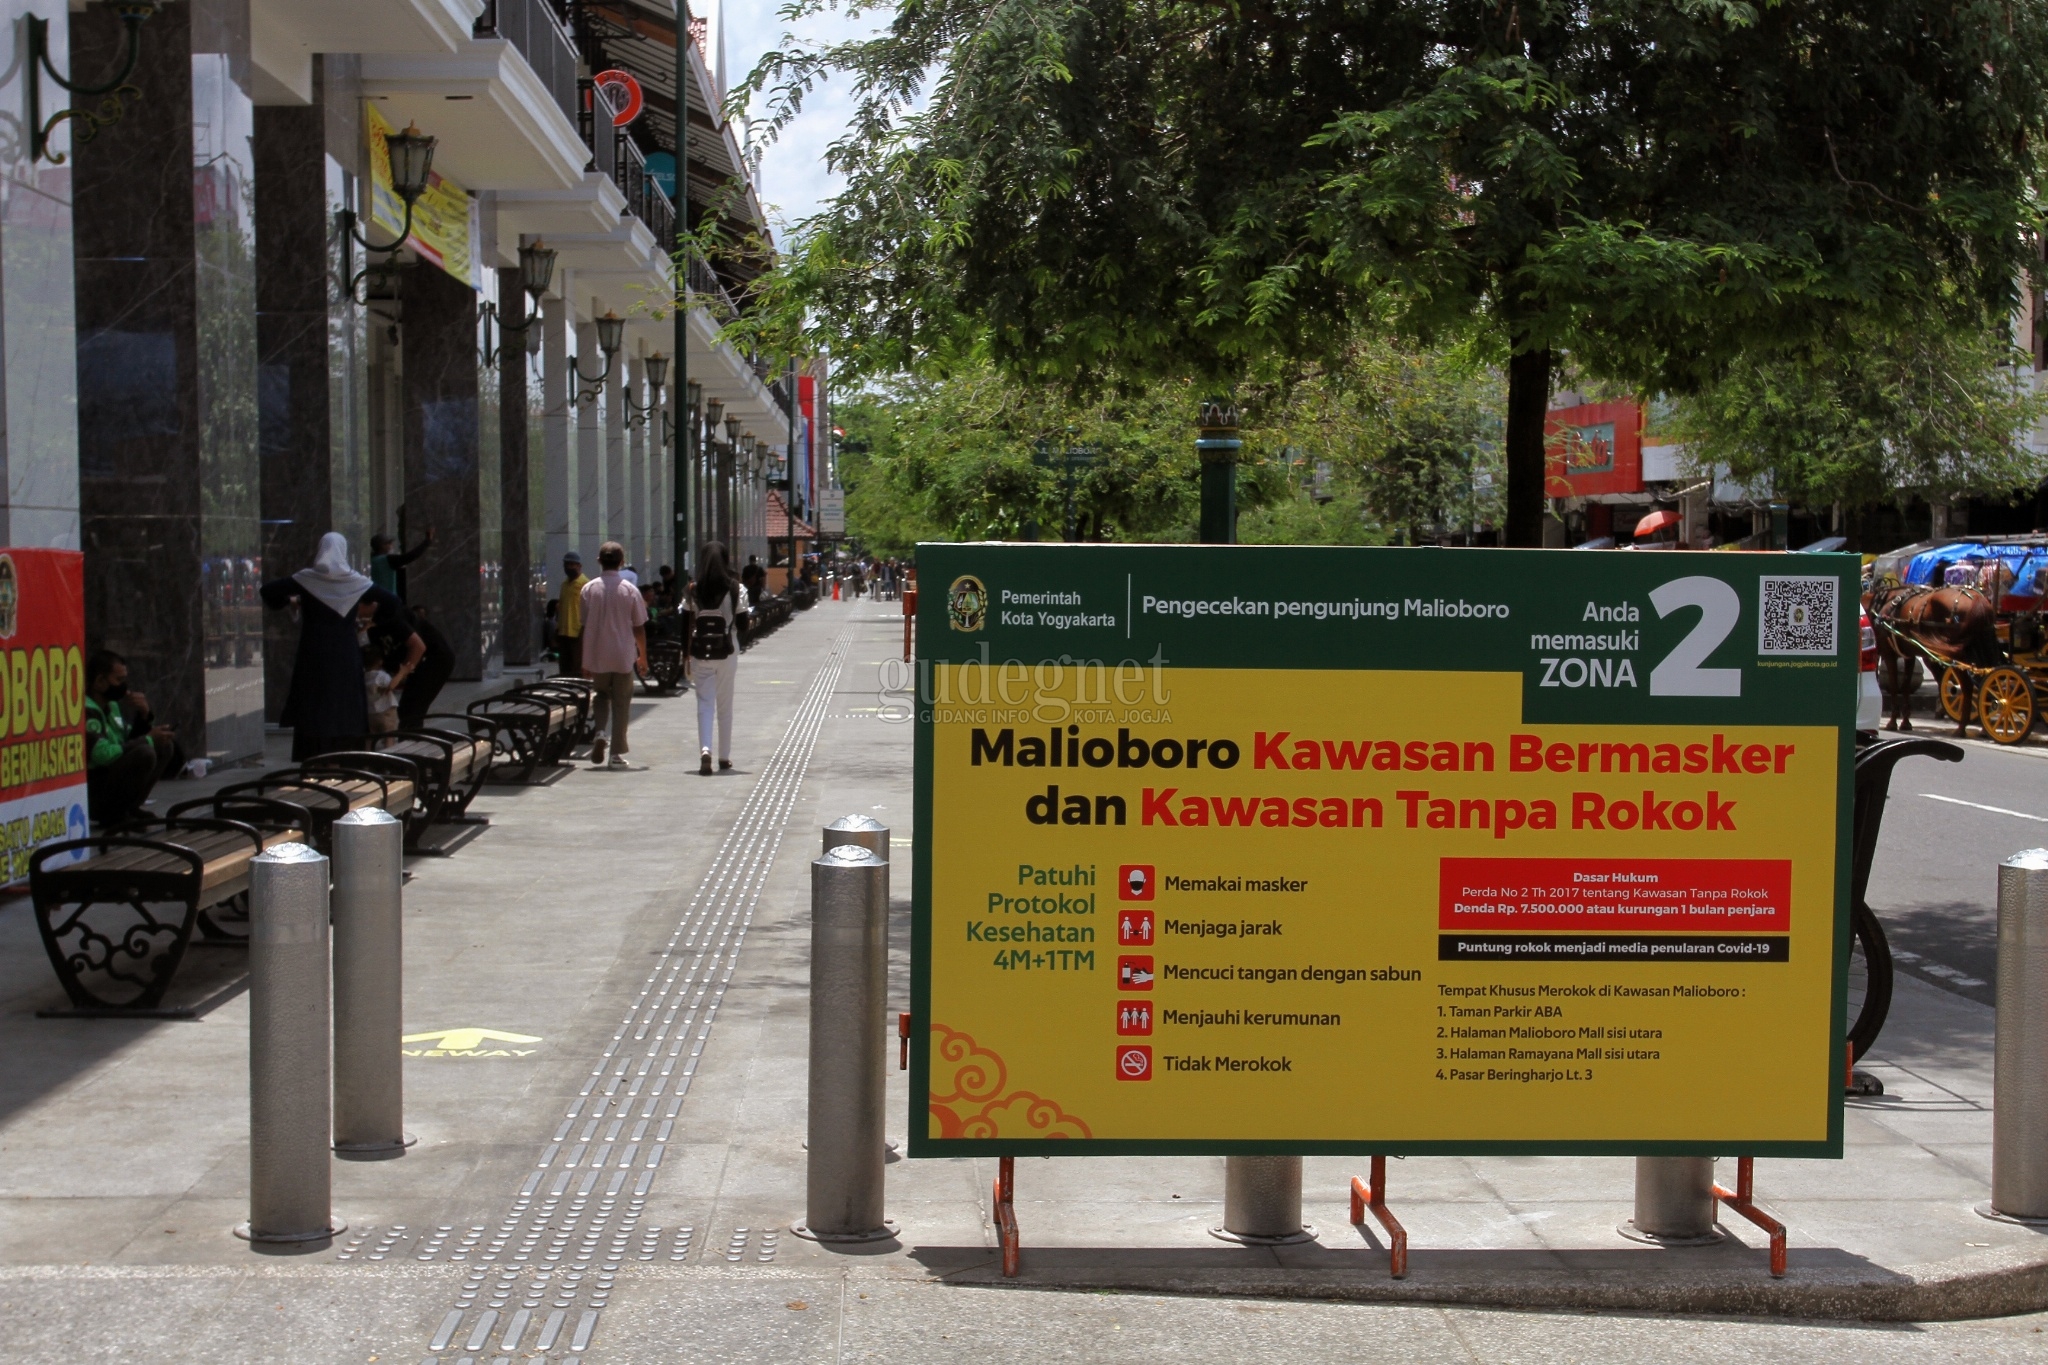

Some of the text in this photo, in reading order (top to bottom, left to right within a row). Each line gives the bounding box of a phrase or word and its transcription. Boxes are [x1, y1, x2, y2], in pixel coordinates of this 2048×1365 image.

[1001, 589, 1081, 606] Pemerintah
[1142, 595, 1510, 621] Pengecekan pengunjung Malioboro
[1582, 600, 1640, 623] Anda
[1001, 610, 1116, 630] Kota Yogyakarta
[1531, 629, 1639, 651] memasuki
[1647, 575, 1742, 697] 2
[1539, 657, 1638, 688] ZONA
[1757, 660, 1838, 669] kunjungan.jogjakota.go.id
[970, 724, 1795, 775] Malioboro Kawasan Bermasker
[1, 733, 84, 789] BERMASKER
[1025, 784, 1738, 840] dan Kawasan Tanpa Rokok
[1018, 864, 1096, 886] Patuhi
[1165, 875, 1309, 893] Memakai masker
[1573, 872, 1659, 883] Dasar Hukum
[988, 892, 1096, 915] Protokol
[1462, 886, 1769, 901] Perda No 2 Th 2017 tentang Kawasan Tanpa Rokok
[1454, 902, 1776, 917] Denda Rp. 7.500.000 atau kurungan 1 bulan penjara
[966, 920, 1095, 943] Kesehatan
[1164, 919, 1283, 939] Menjaga jarak
[1457, 941, 1770, 956] Puntung rokok menjadi media penularan Covid-19
[993, 949, 1095, 971] 4M+1TM
[1163, 964, 1422, 985] Mencuci tangan dengan sabun
[1437, 984, 1487, 999] Tempat
[1489, 984, 1536, 997] Khusus
[1538, 984, 1596, 997] Merokok
[1598, 984, 1612, 997] di
[1613, 985, 1671, 997] Kawasan
[1672, 984, 1740, 998] Malioboro
[1163, 1009, 1341, 1028] Menjauhi kerumunan
[1436, 1005, 1563, 1018] 1. Taman Parkir ABA
[1436, 1026, 1663, 1039] 2. Halaman Malioboro Mall sisi utara
[1162, 1055, 1292, 1072] Tidak Merokok
[1436, 1047, 1660, 1062] 3. Halaman Ramayana Mall sisi utara
[1435, 1068, 1593, 1083] 4. Pasar Beringharjo Lt. 3
